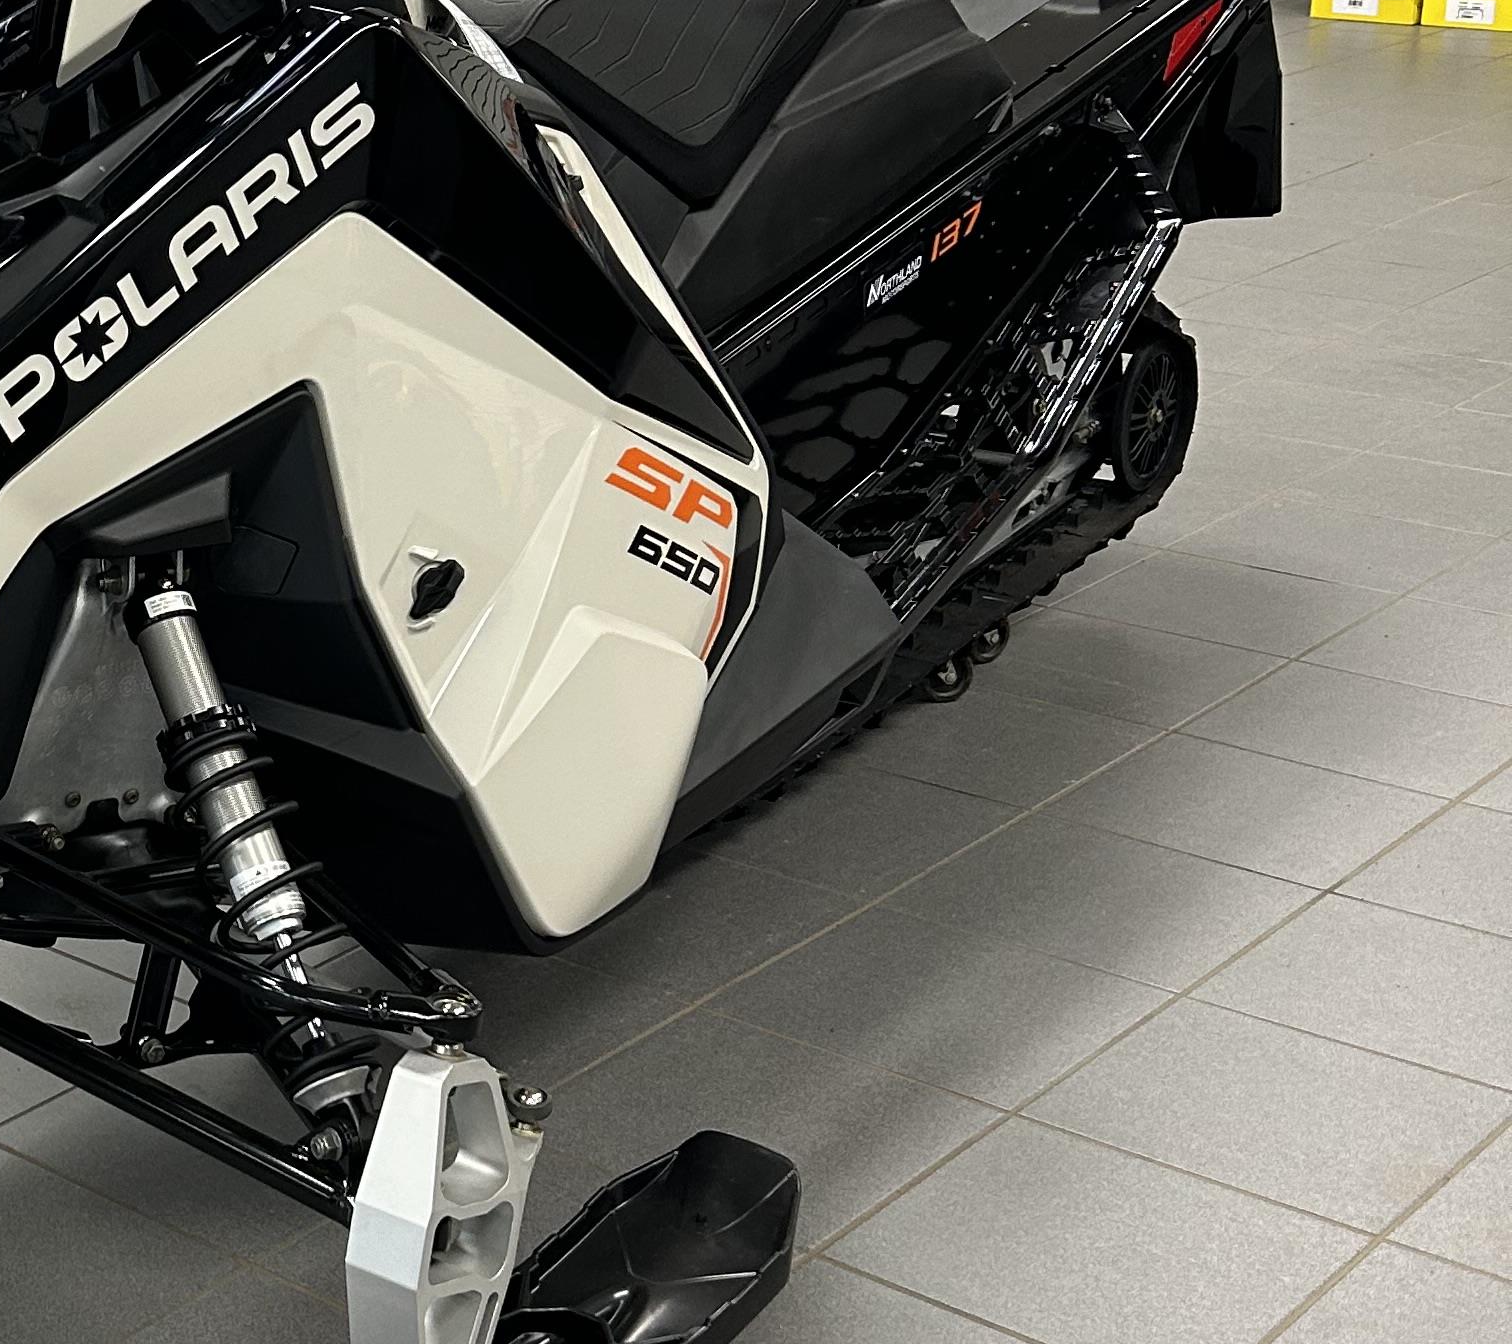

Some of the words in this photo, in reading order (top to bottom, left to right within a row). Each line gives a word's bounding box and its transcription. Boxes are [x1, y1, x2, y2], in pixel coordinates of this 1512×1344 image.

[930, 200, 983, 263] 137
[604, 446, 734, 530] SP
[626, 524, 721, 596] 650
